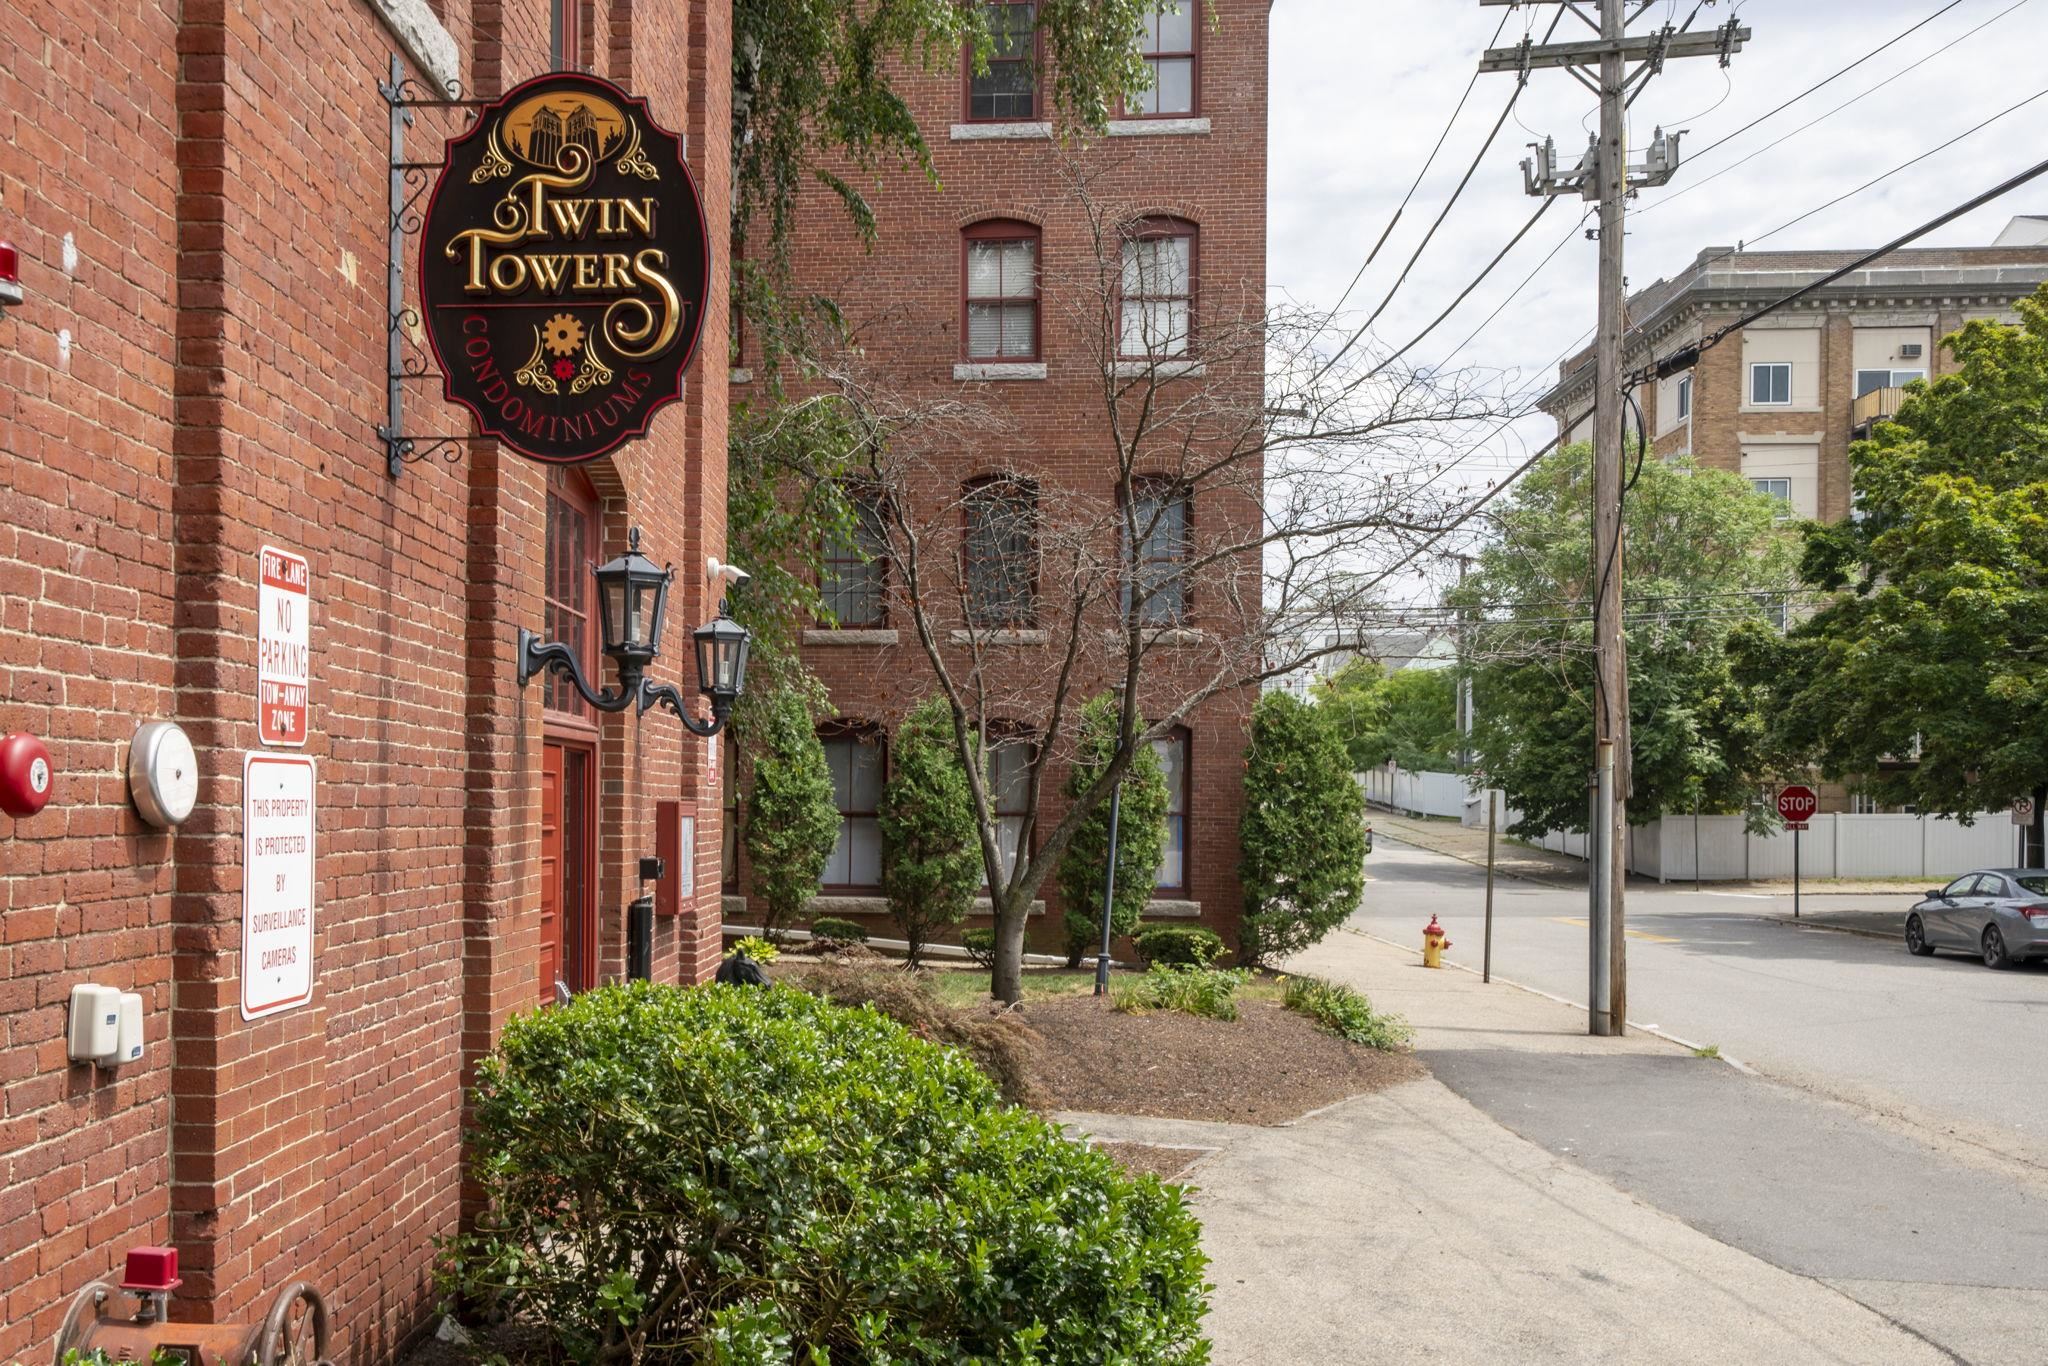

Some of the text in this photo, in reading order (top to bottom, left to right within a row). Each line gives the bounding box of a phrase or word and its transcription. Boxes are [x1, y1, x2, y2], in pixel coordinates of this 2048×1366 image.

[462, 314, 652, 442] CONDOMINIUMS
[263, 554, 306, 587] FIRE LANE
[277, 597, 292, 634] NO
[261, 638, 307, 678] PARKING
[262, 682, 306, 708] TOW-AWAY
[271, 710, 295, 732] ZONE
[253, 799, 308, 817] THIS PROPERTY
[1780, 797, 1814, 811] STOP
[255, 836, 306, 856] IS PROTECTED
[276, 874, 286, 892] BY
[253, 908, 306, 933] SURVEILLANCE
[261, 945, 297, 970] CAMERAS
